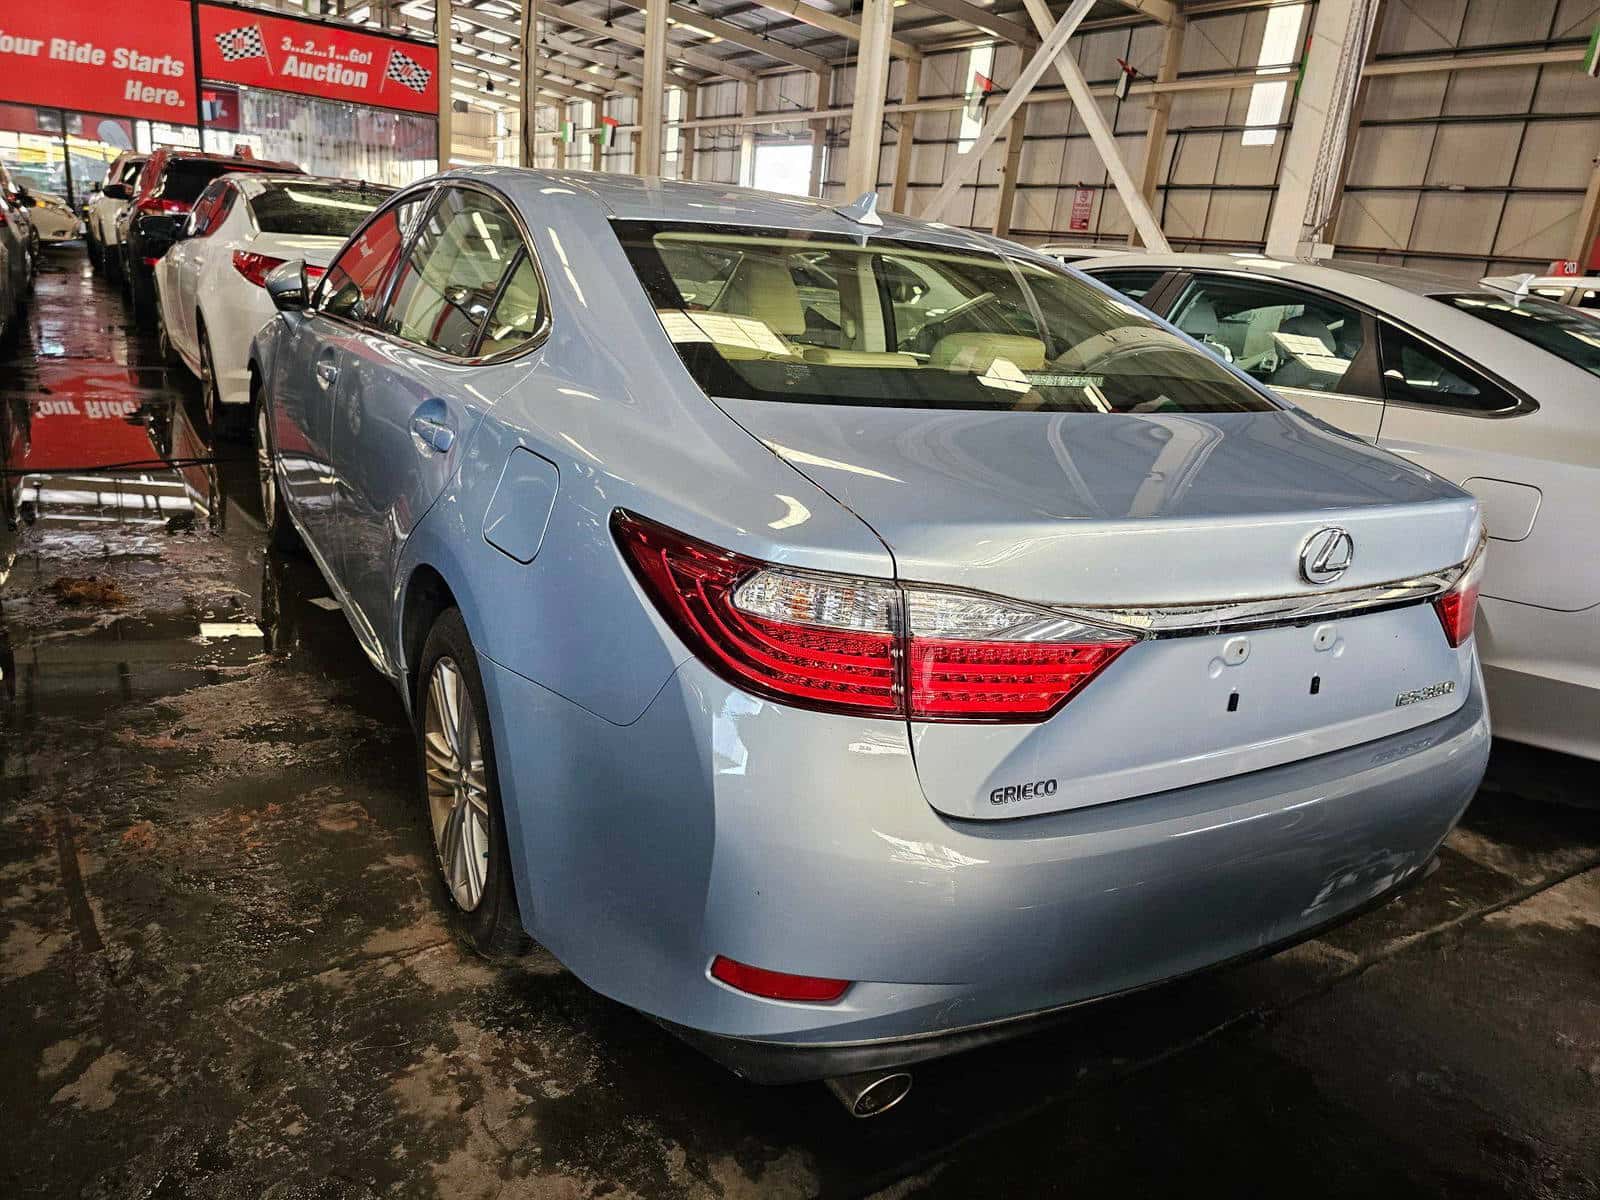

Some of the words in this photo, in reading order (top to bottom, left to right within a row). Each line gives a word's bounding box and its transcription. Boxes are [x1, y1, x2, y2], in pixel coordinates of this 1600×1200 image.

[50, 38, 106, 66] Ride
[112, 47, 185, 77] Starts
[281, 55, 369, 88] Auction
[125, 80, 185, 107] Here.
[990, 779, 1057, 805] GRIECO
